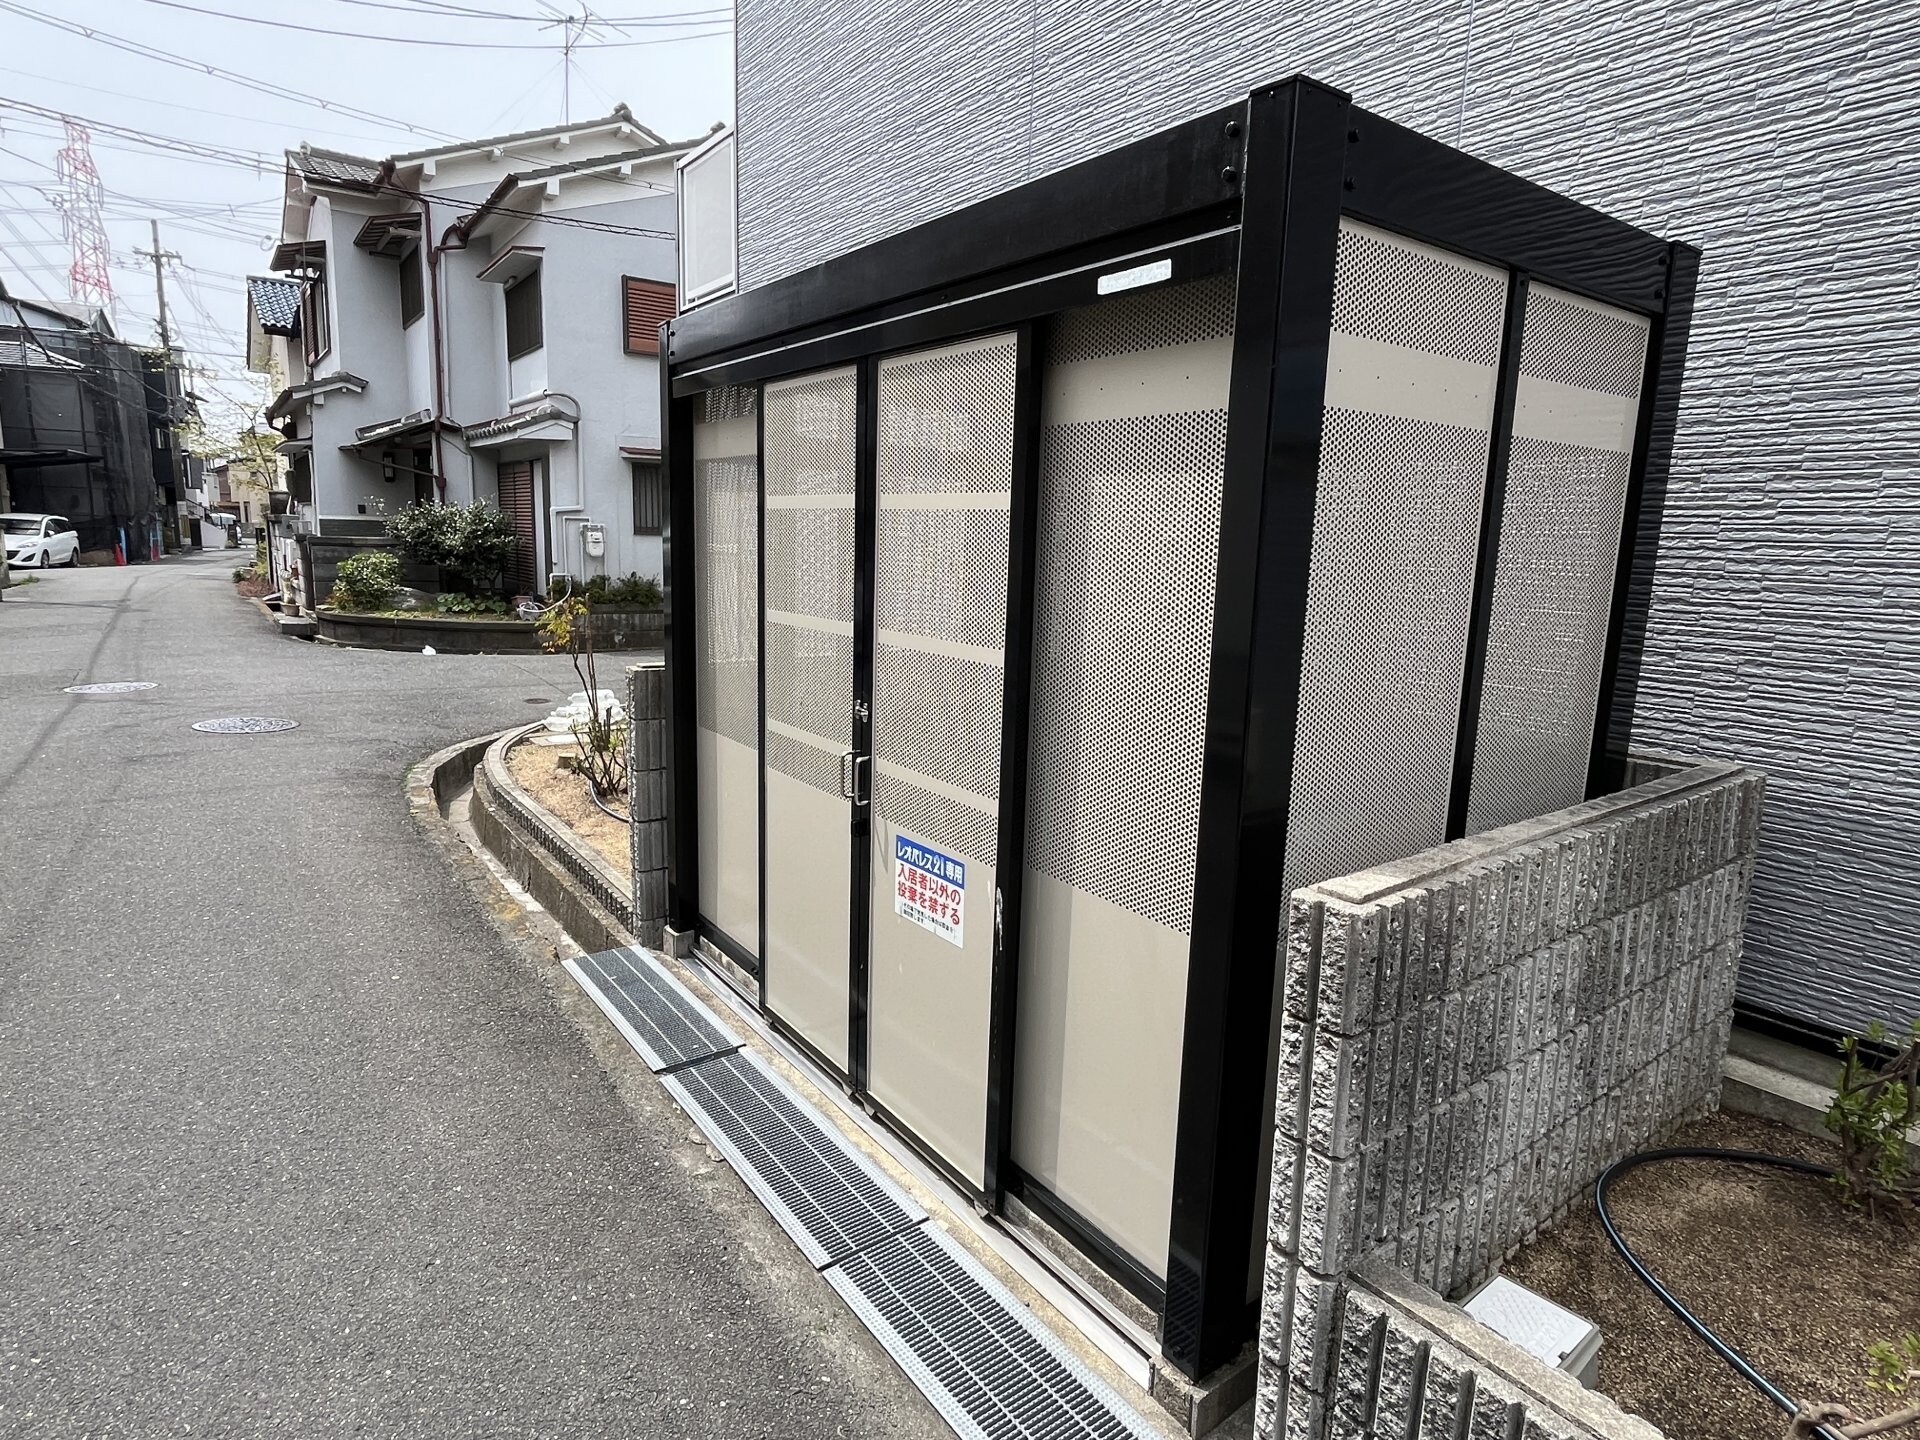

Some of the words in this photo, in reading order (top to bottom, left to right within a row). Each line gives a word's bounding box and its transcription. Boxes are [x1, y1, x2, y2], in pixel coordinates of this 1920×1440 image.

[898, 863, 961, 906] 入居者以外の
